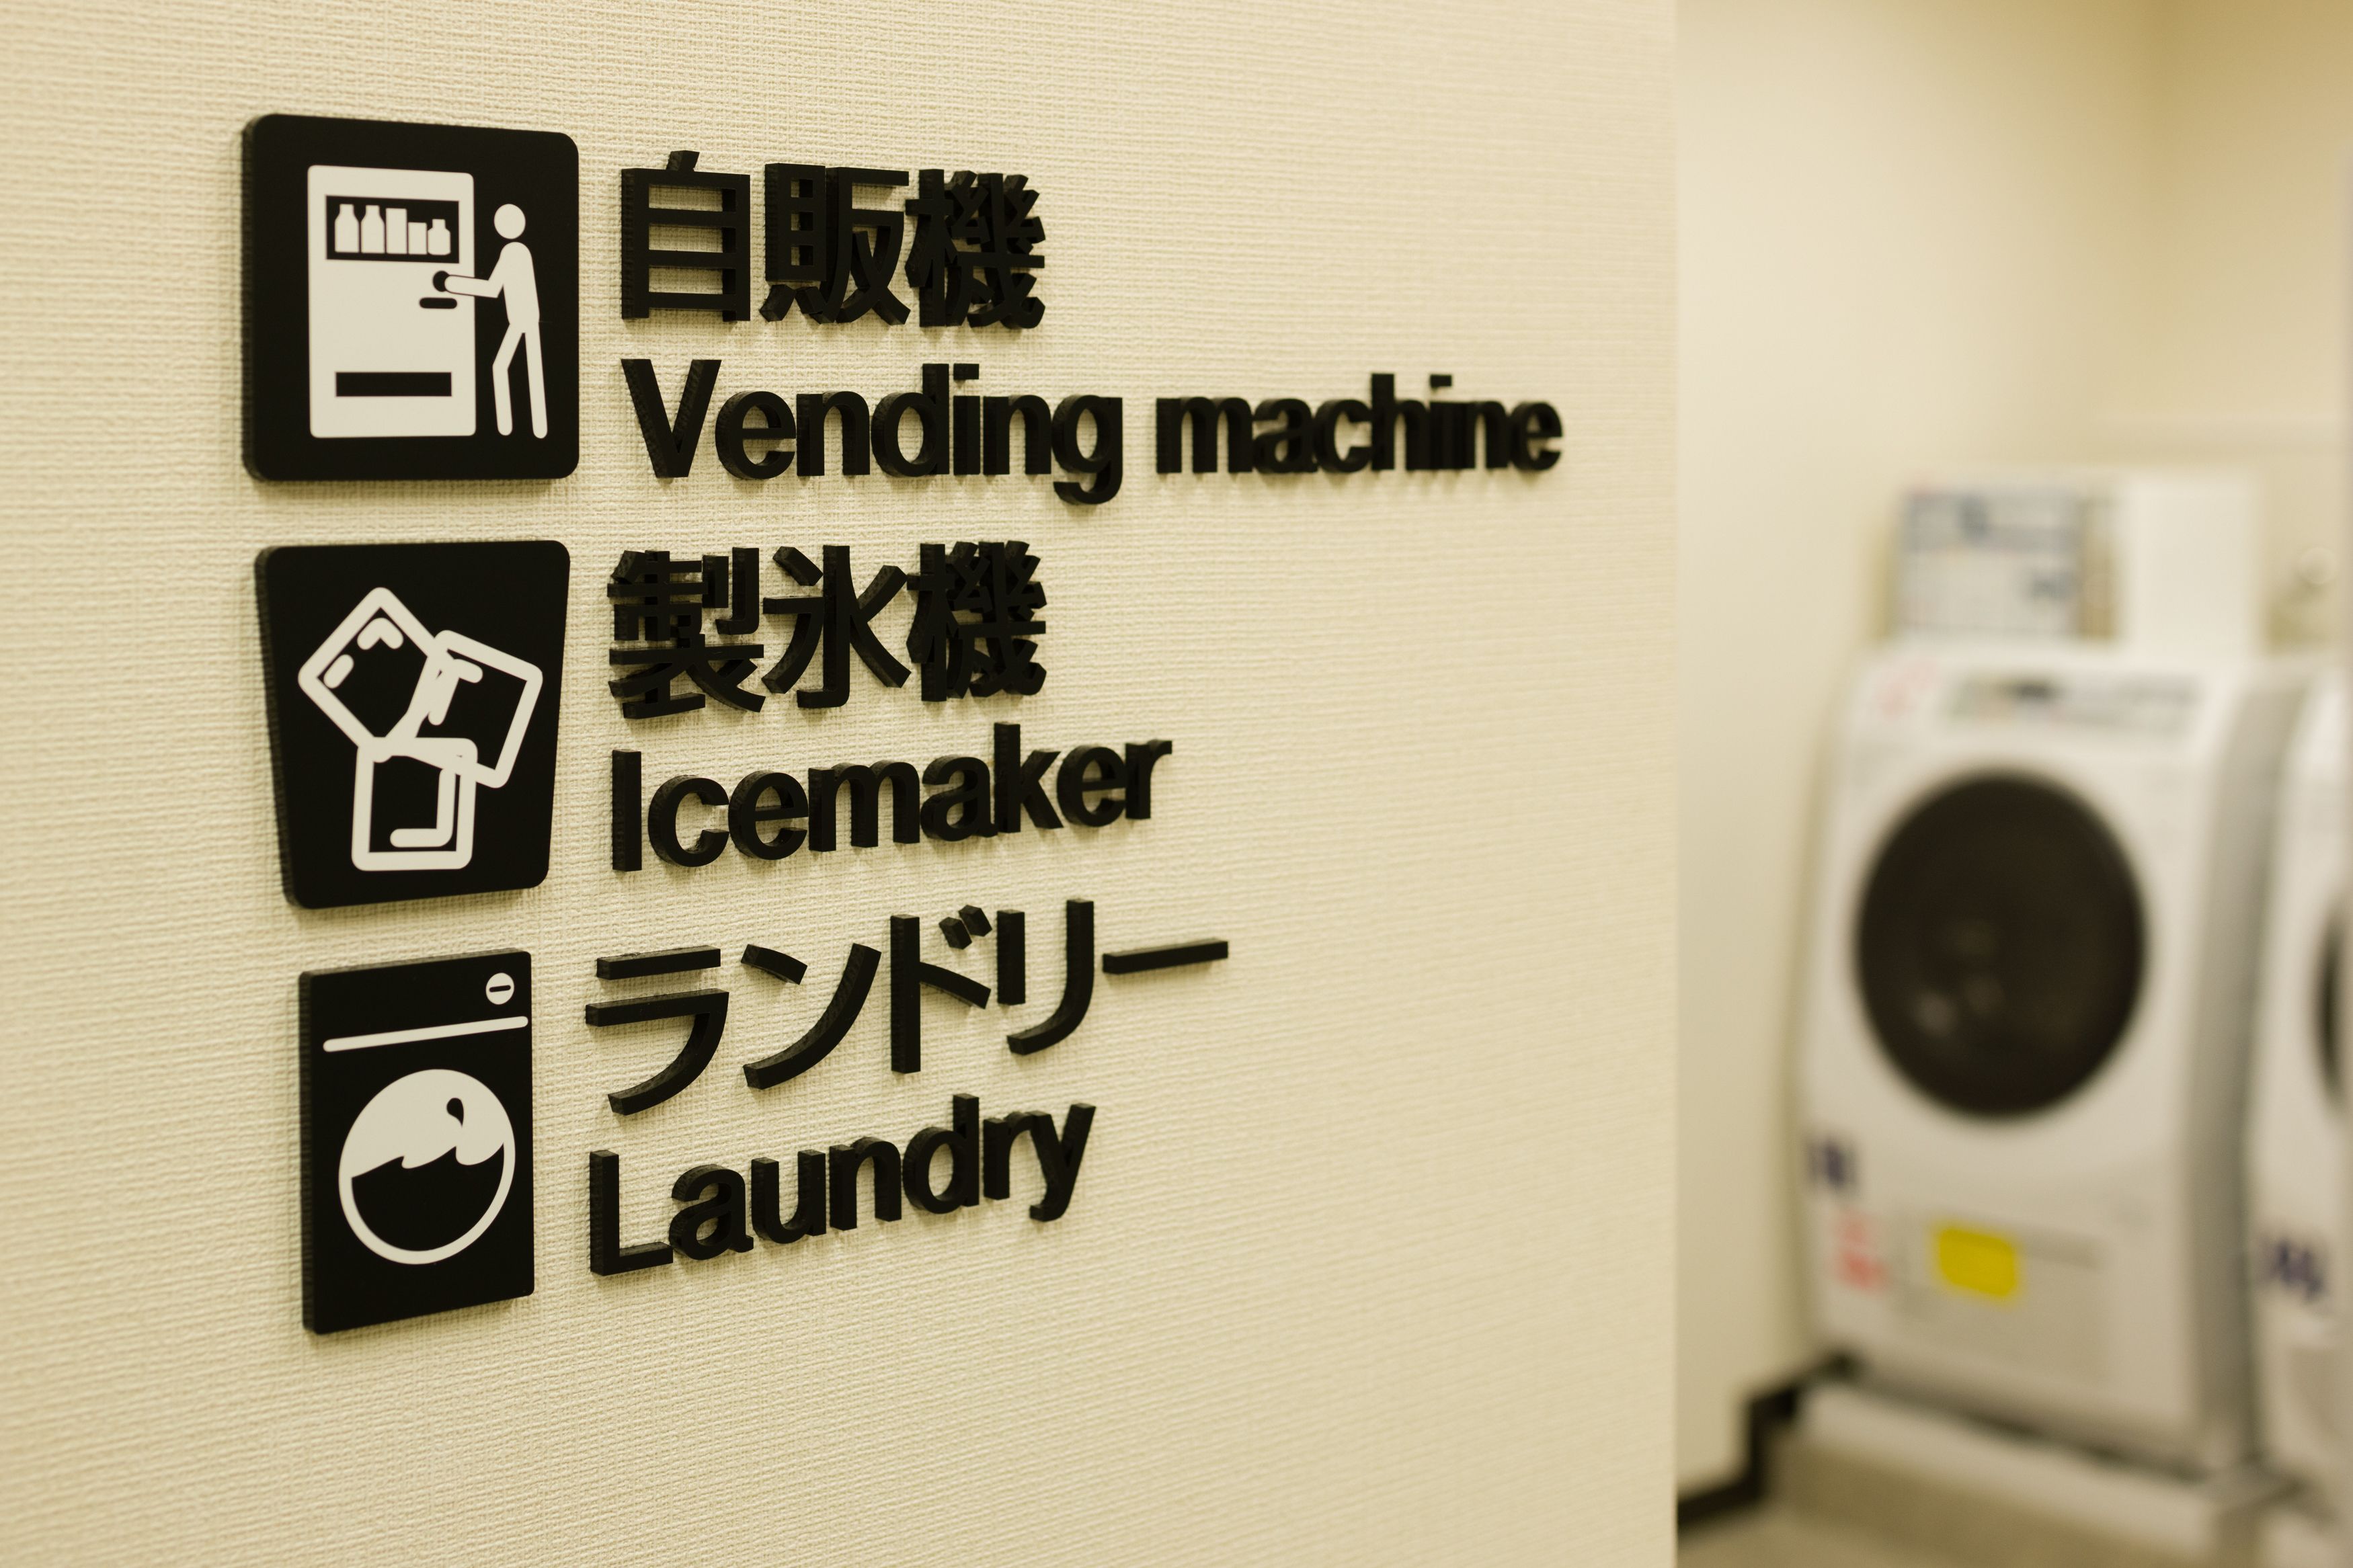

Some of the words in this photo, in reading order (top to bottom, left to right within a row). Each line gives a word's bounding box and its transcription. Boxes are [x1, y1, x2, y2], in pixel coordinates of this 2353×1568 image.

[619, 149, 1047, 331] 自販機
[620, 358, 1124, 507] Vending
[1155, 373, 1564, 479] machine
[606, 540, 1048, 721] 製氷機
[610, 723, 1172, 873] Icemaker
[584, 899, 1229, 1117] ランドリー
[588, 1094, 1096, 1278] Laundry
